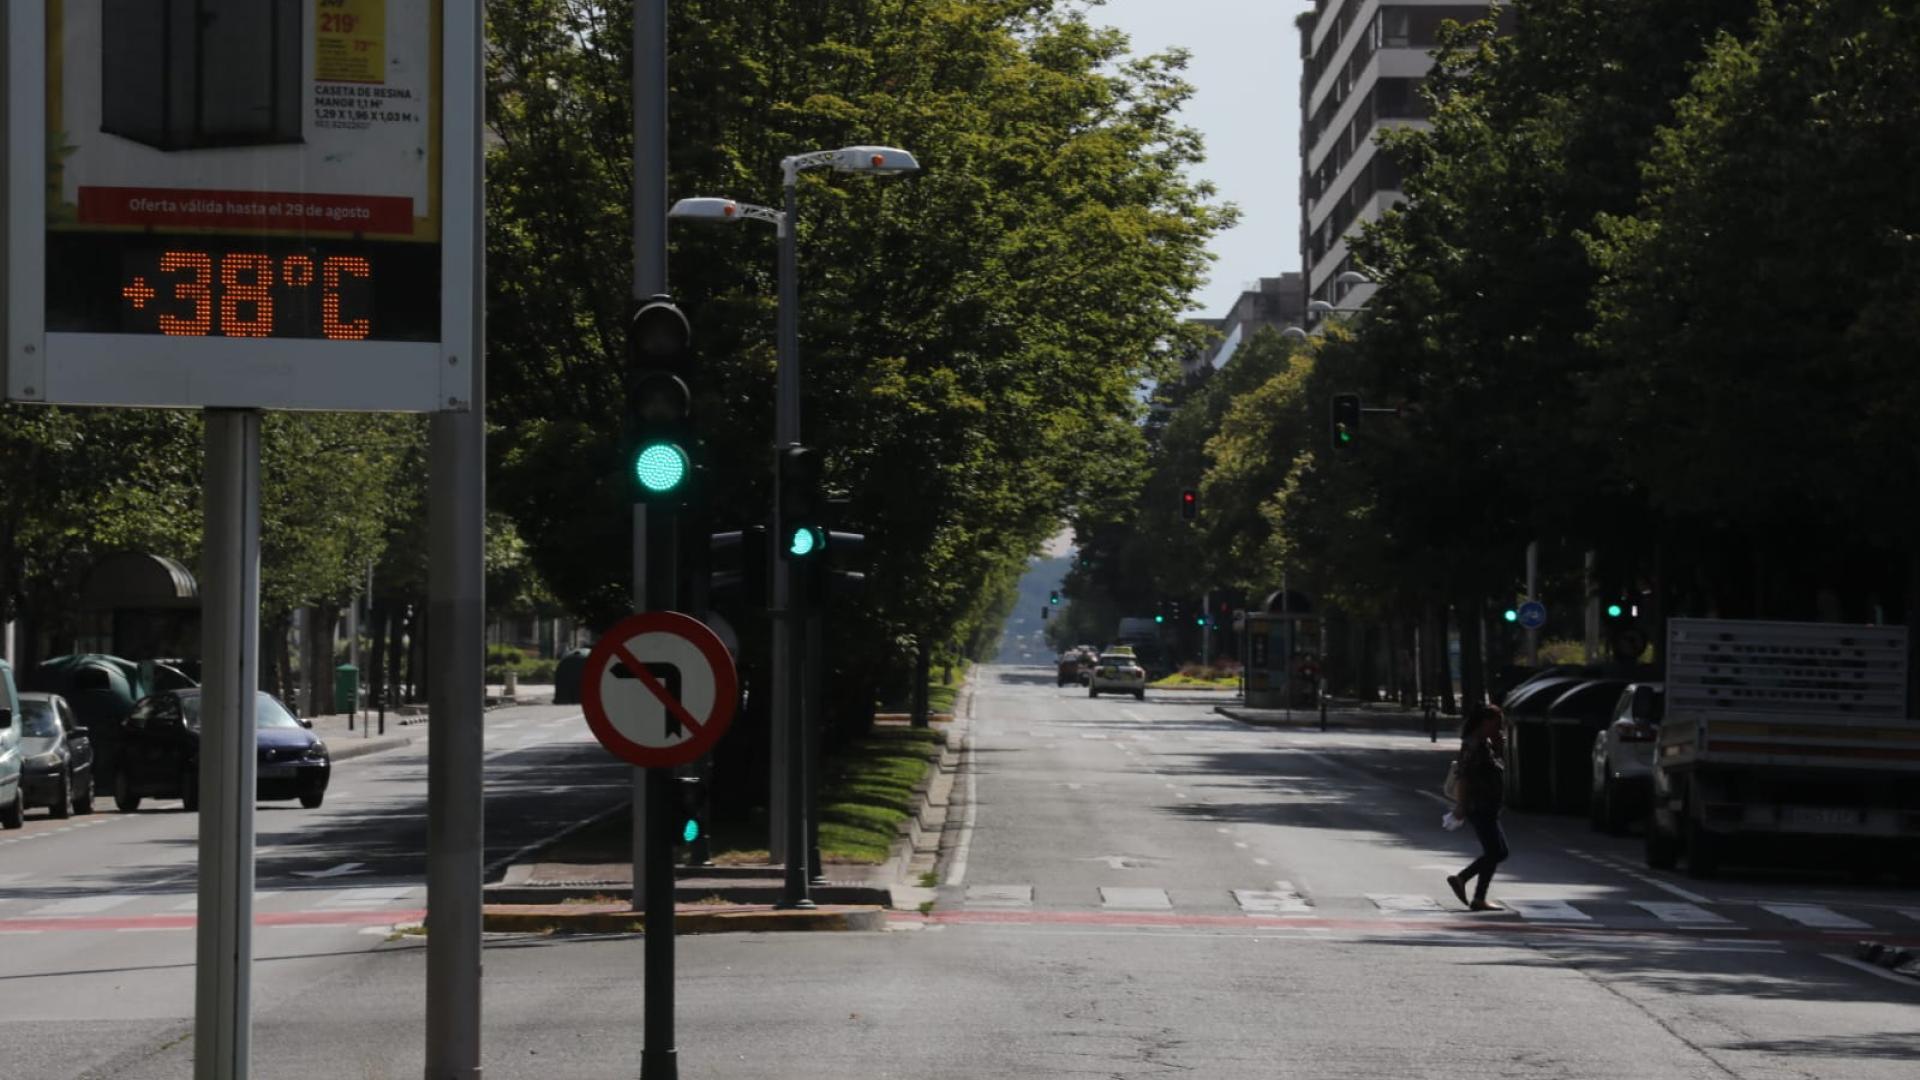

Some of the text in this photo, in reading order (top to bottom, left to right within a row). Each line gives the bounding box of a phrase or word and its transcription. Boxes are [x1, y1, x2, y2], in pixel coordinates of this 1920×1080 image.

[314, 85, 412, 99] CASETA DE RESINA
[314, 97, 355, 108] MANOR
[129, 197, 371, 221] Oferta válida hasta el 29 de agosto
